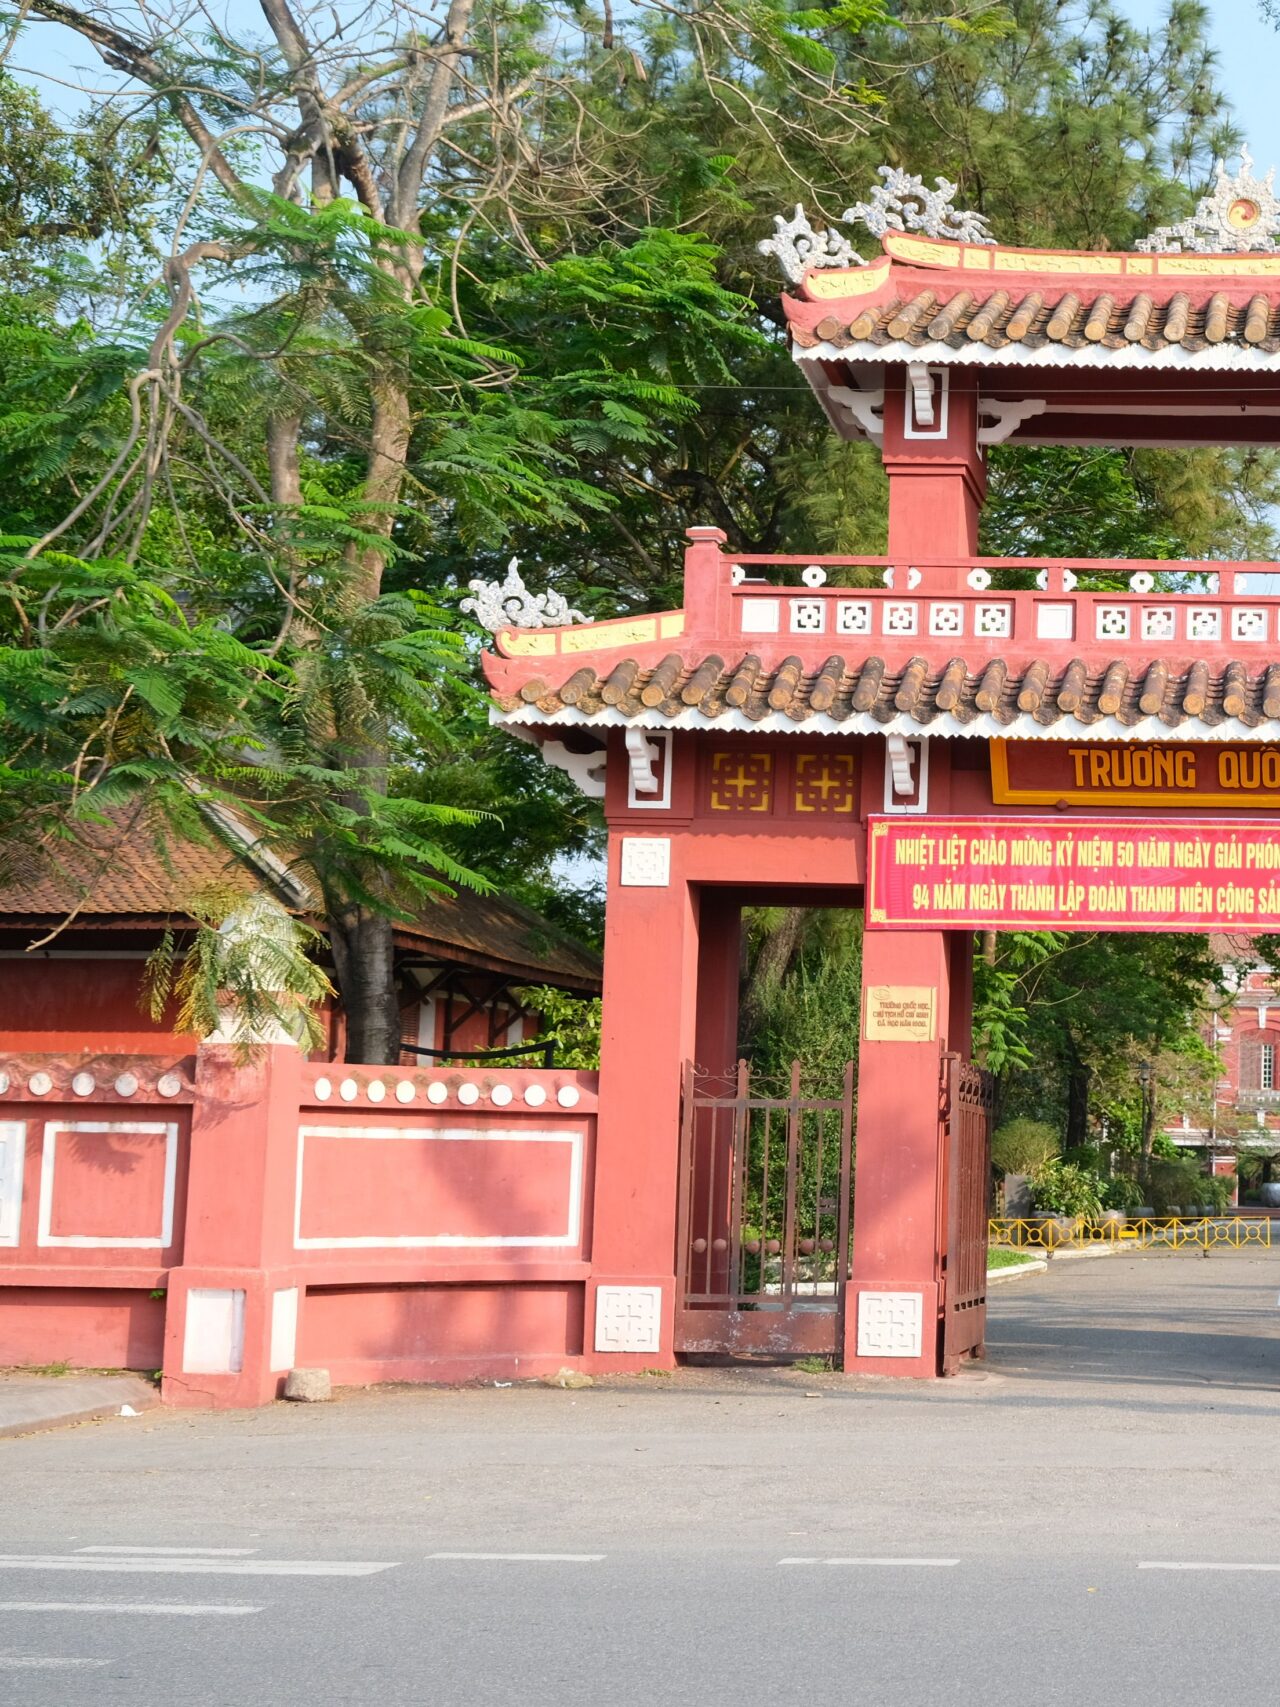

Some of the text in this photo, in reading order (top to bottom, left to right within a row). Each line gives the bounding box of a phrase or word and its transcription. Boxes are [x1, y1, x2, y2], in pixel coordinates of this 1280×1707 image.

[1068, 743, 1196, 788] TRƯỜNG
[895, 834, 935, 871] NHIỆT
[939, 834, 967, 871] LIỆT
[970, 835, 1007, 867] CHÀO
[1011, 836, 1053, 867] MỪNG
[1056, 833, 1075, 867] KỶ
[1078, 836, 1113, 873] NIỆM
[1117, 841, 1134, 868] 50
[1138, 837, 1170, 868] NĂM
[1174, 837, 1210, 869] NGÀY
[1215, 834, 1242, 869] GIẢI
[913, 884, 930, 910] 94
[933, 880, 966, 911] NĂM
[969, 880, 1006, 911] NGÀY
[1010, 881, 1055, 912] THÀNH
[1059, 880, 1085, 917] LẬP
[1088, 881, 1127, 912] ĐOÀN
[1130, 886, 1176, 913] THANH
[1179, 882, 1213, 913] NIÊN
[1216, 882, 1254, 919] CỘNG
